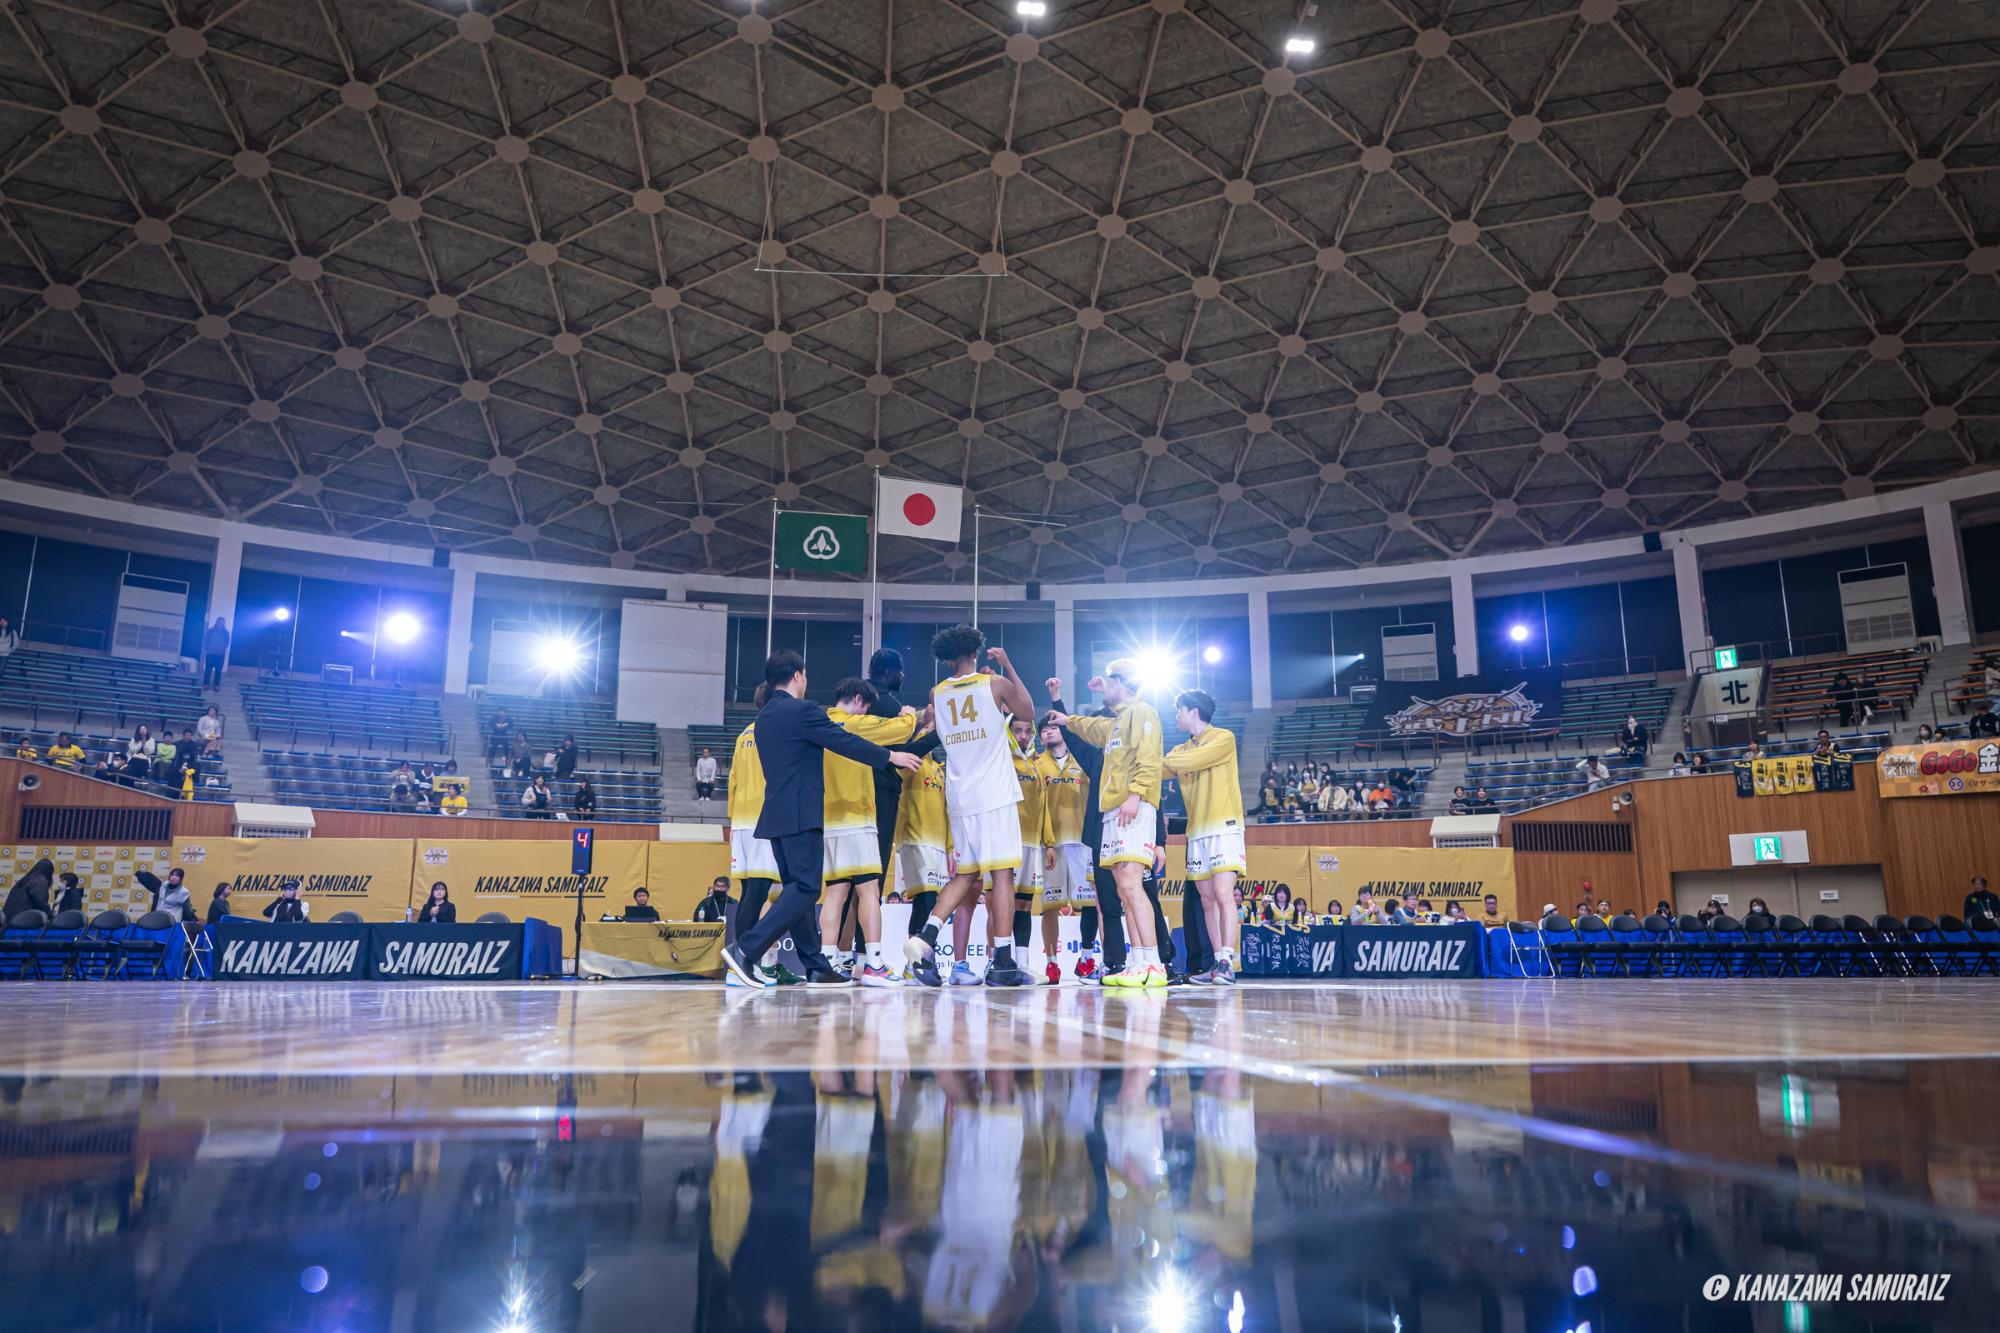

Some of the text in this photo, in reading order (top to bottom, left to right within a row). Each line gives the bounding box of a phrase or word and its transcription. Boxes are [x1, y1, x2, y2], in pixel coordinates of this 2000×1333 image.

[1721, 680, 1750, 705] 北
[947, 694, 978, 726] 14
[945, 727, 987, 746] CORDILIA
[1921, 749, 1977, 775] GoGo
[577, 832, 589, 849] 4
[305, 875, 372, 892] SAMURAIZ
[474, 876, 543, 893] KANAZAWA
[1427, 881, 1484, 897] SAMURAIZ
[220, 940, 511, 975] KANAZAWA SAMURAIZ
[1354, 939, 1466, 972] SAMURAIZ
